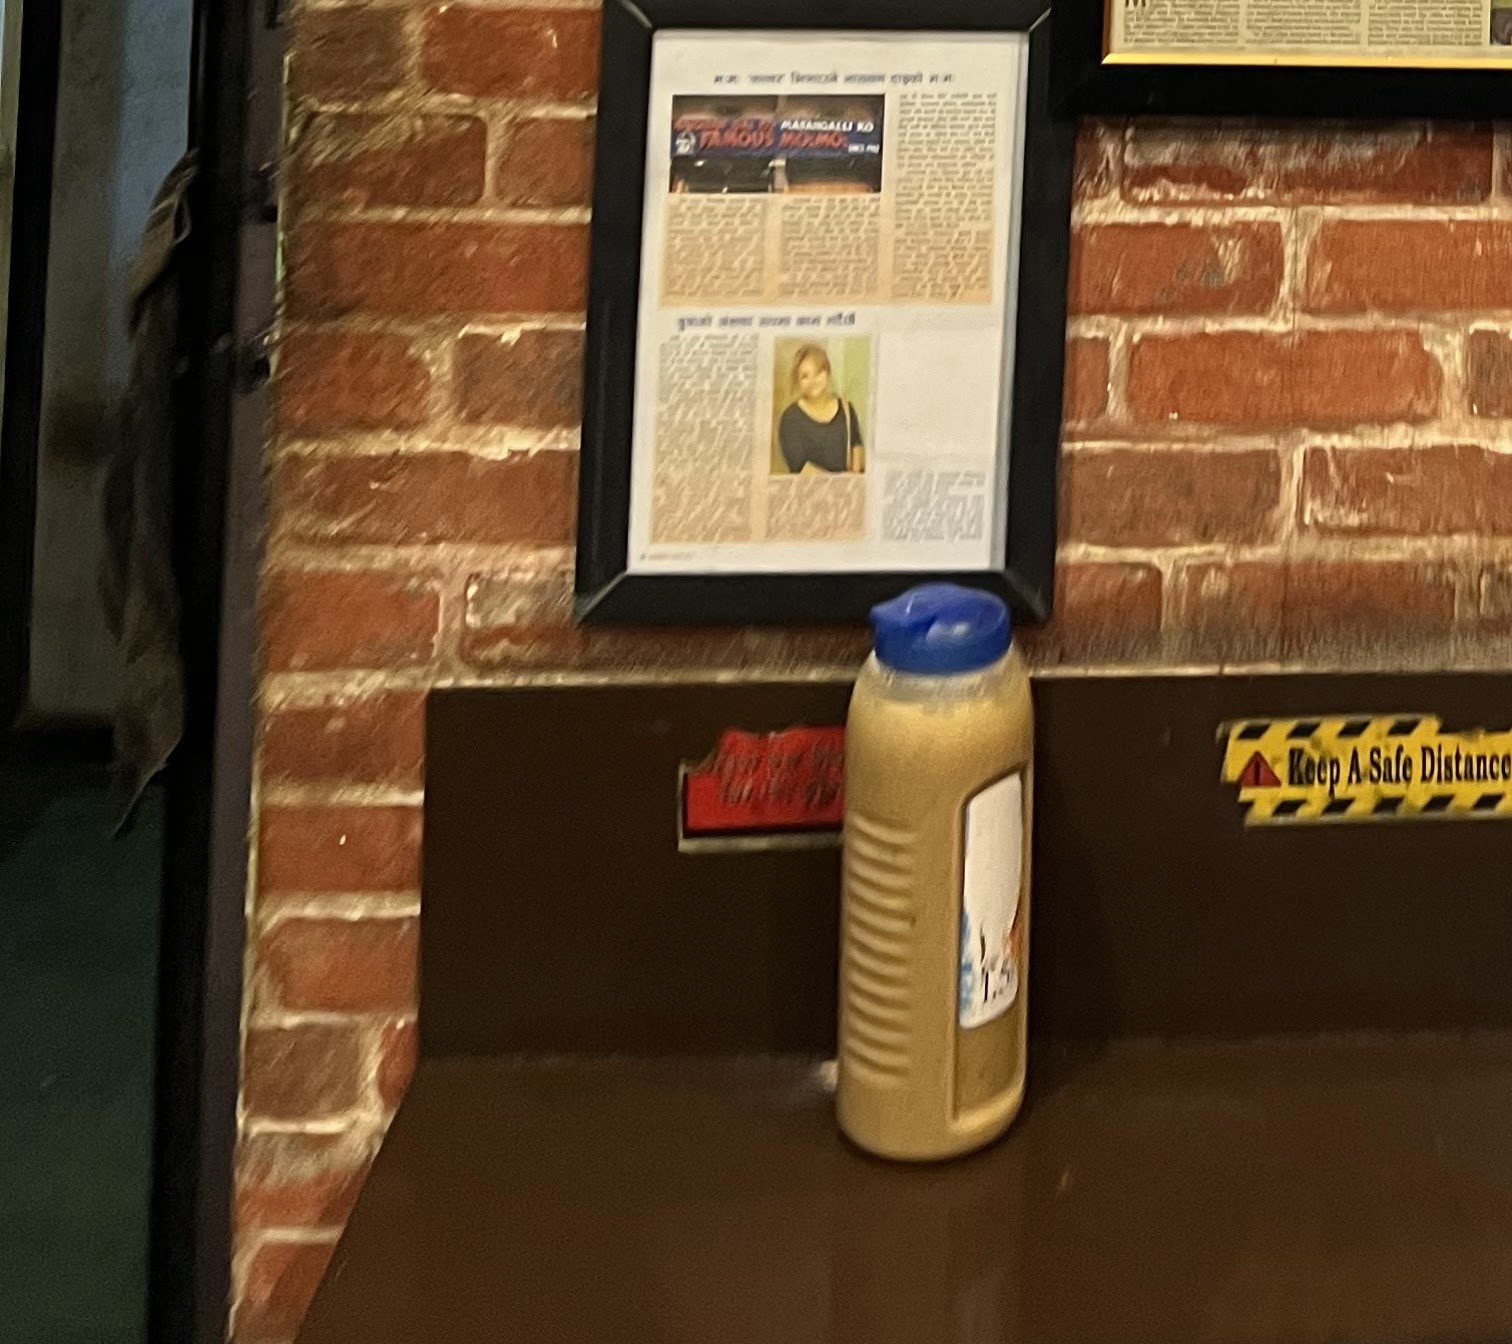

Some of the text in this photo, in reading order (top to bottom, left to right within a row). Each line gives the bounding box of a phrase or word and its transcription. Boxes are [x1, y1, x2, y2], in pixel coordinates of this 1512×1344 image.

[1288, 743, 1512, 798] Keep A Safe Distance
